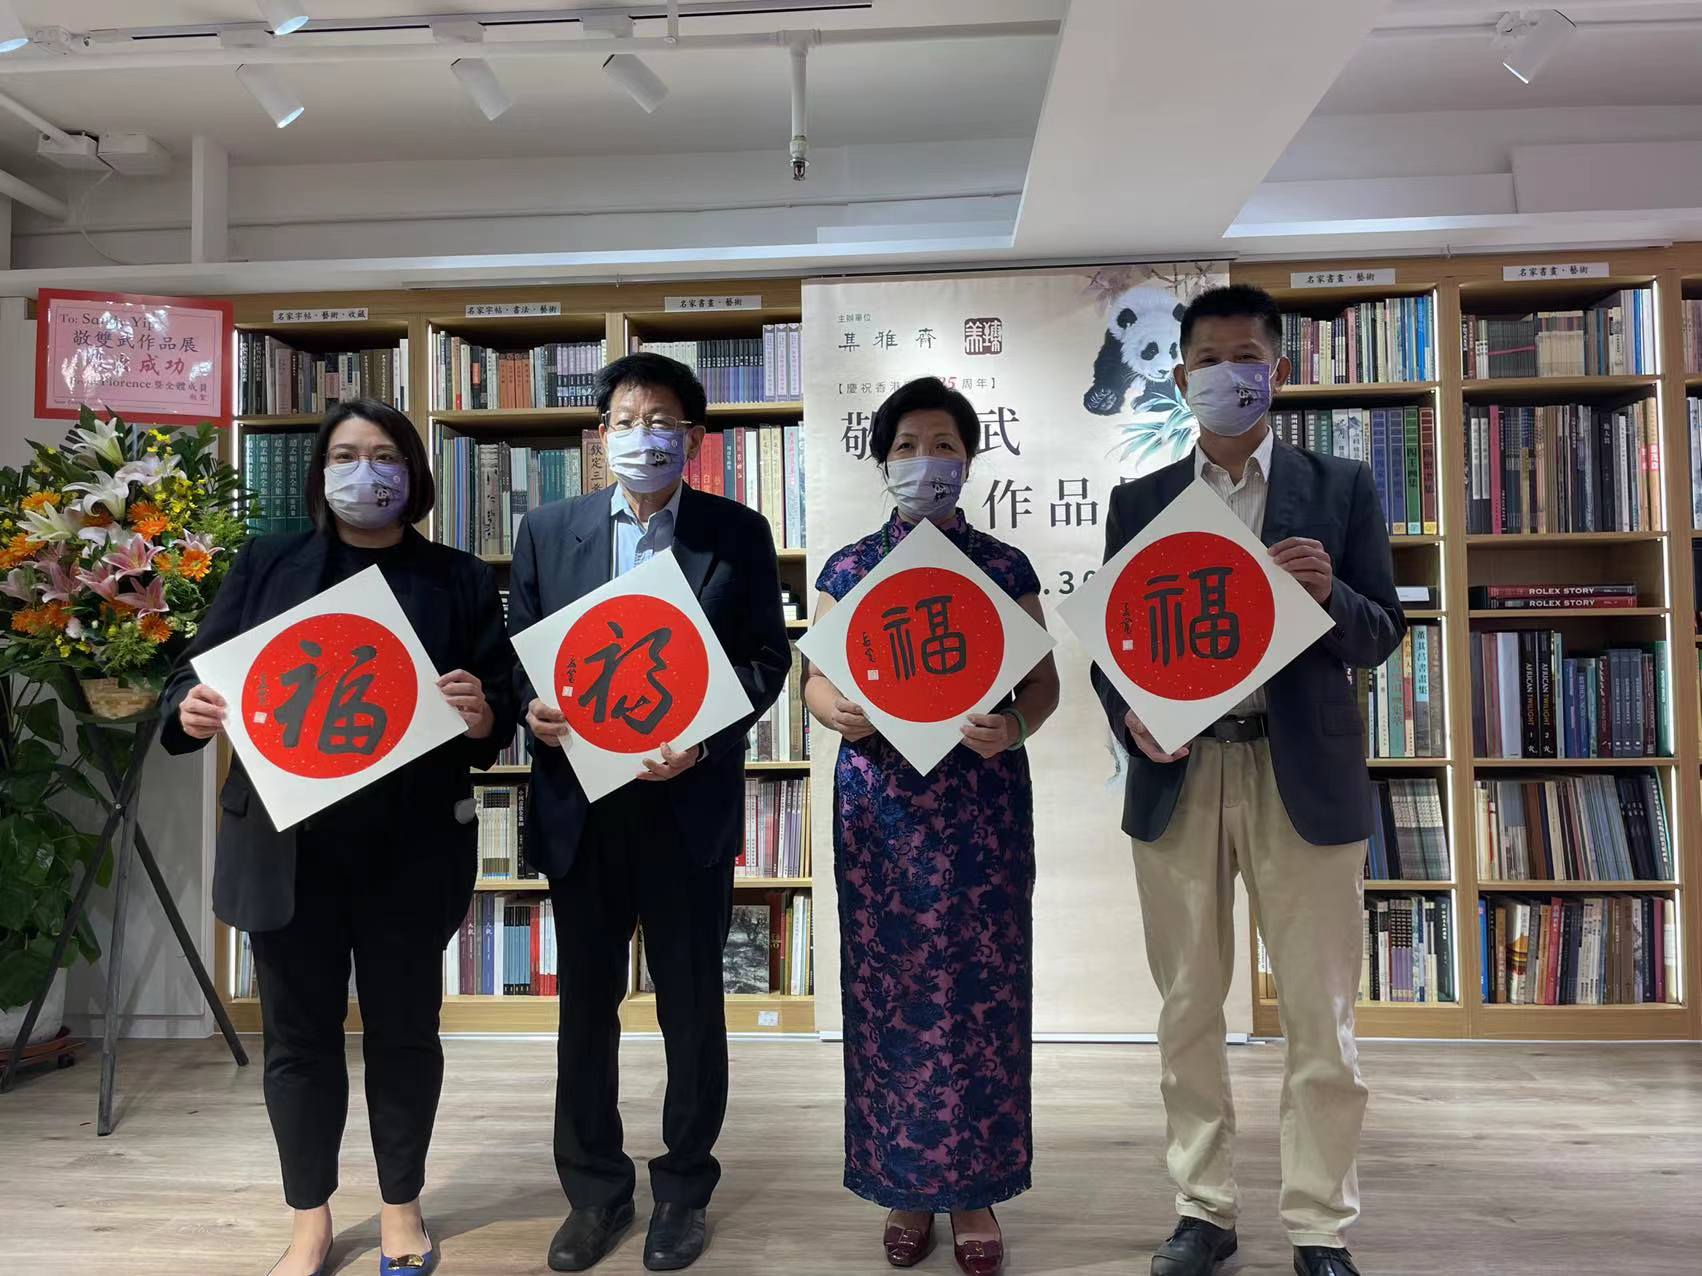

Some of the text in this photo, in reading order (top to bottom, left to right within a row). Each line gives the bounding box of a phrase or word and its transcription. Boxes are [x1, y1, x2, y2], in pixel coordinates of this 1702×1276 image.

[60, 313, 78, 325] To:
[838, 313, 872, 323] 主辦單位
[982, 477, 1138, 530] 作品
[1529, 599, 1560, 607] ROLEX
[1563, 598, 1595, 607] STORY
[1563, 587, 1595, 595] STORY
[1144, 566, 1240, 667] 福
[881, 595, 967, 681] 福
[273, 639, 388, 755] 福
